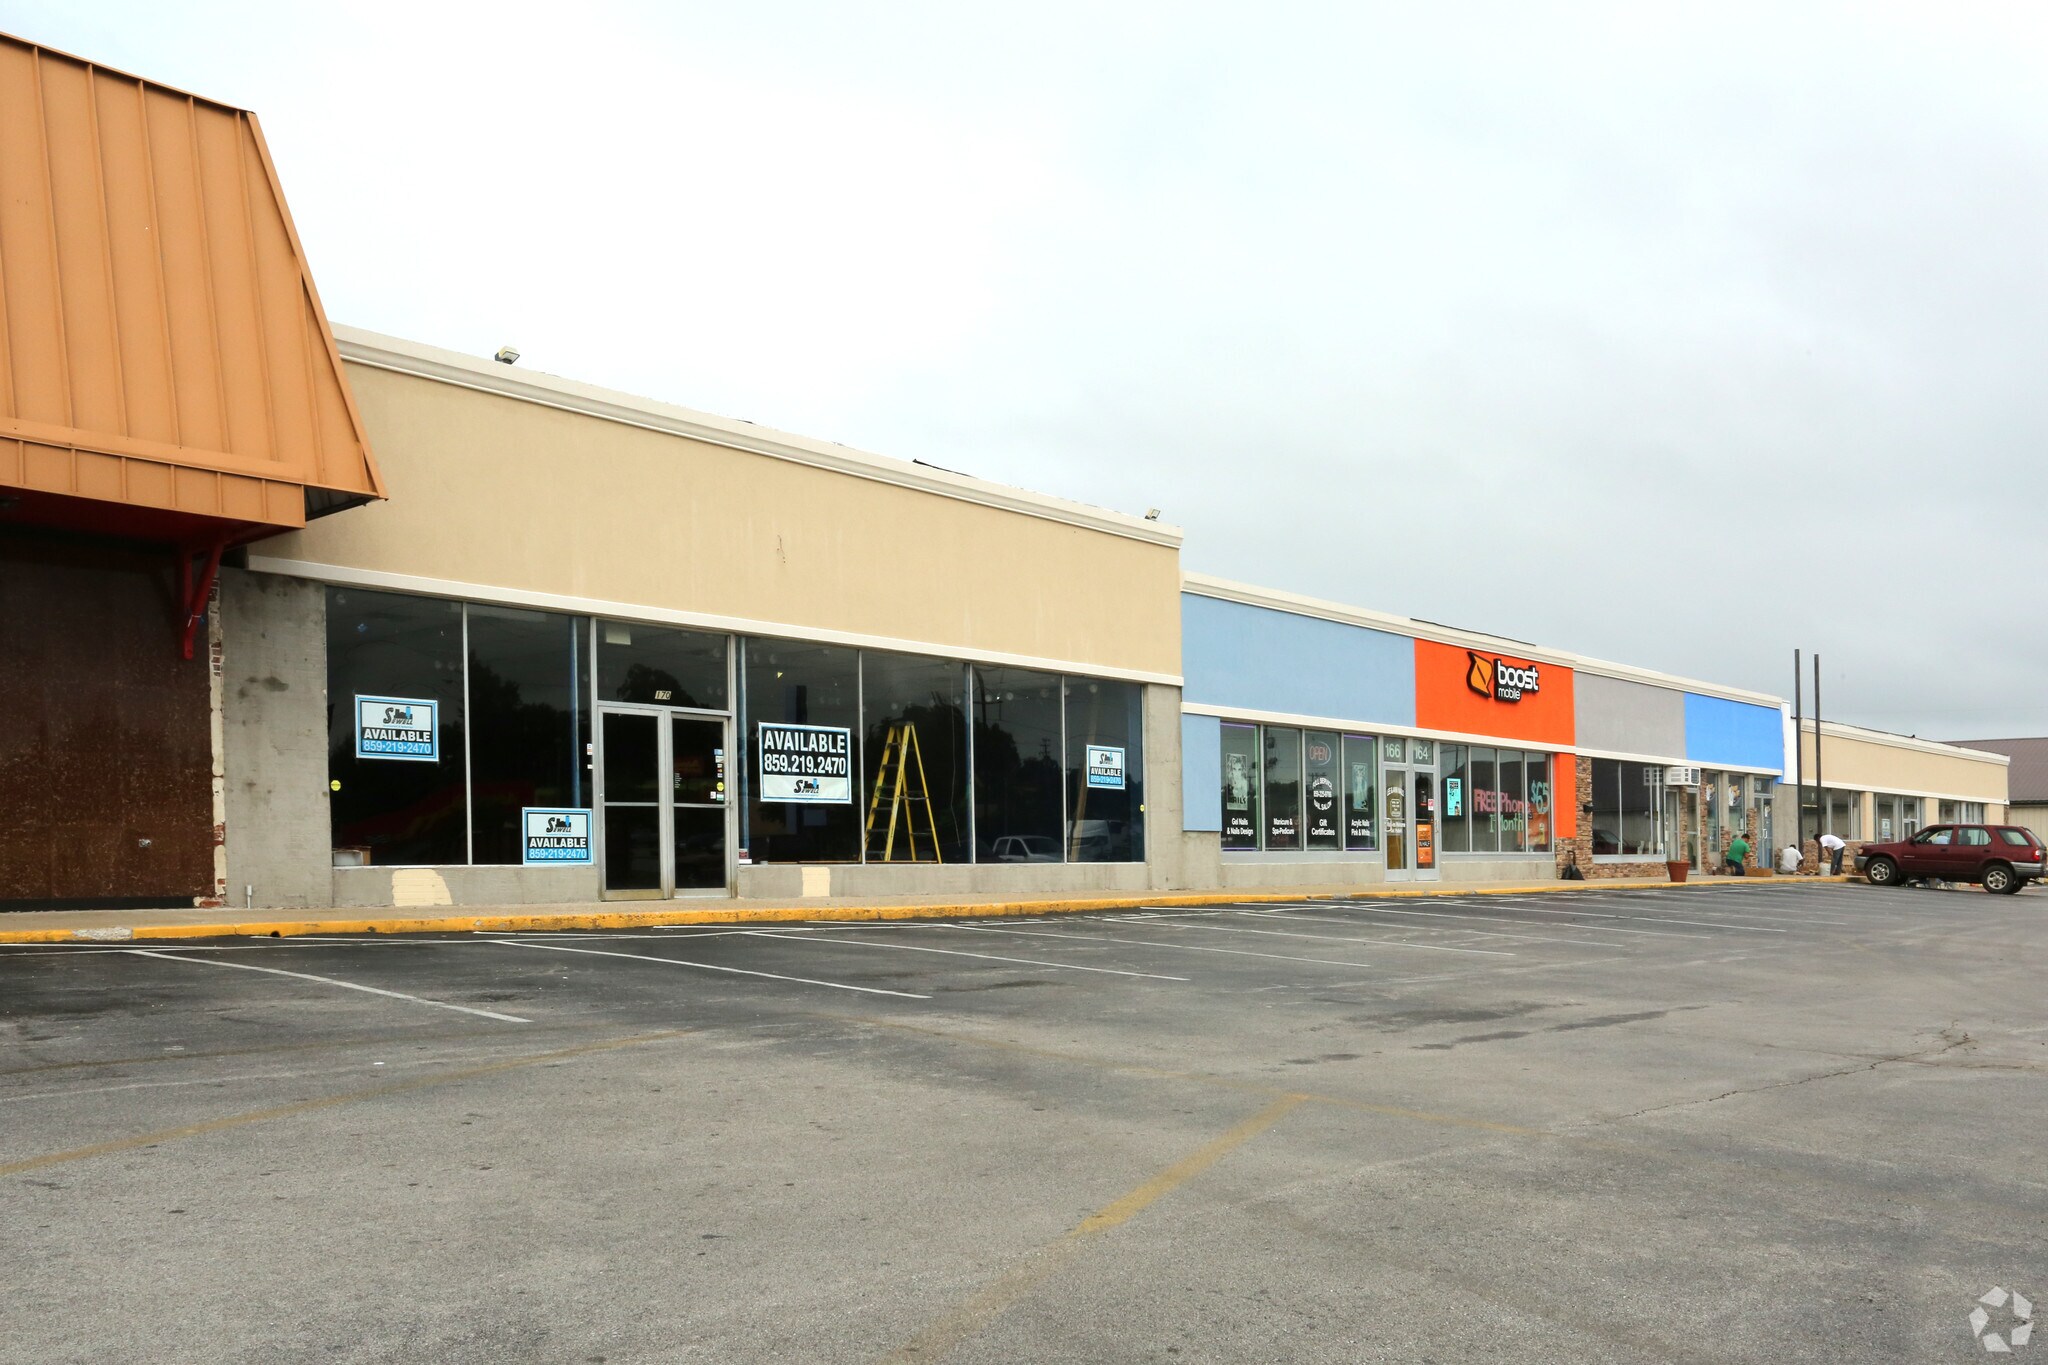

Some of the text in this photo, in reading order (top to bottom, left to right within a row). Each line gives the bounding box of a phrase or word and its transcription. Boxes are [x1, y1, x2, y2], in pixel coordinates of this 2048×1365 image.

[1498, 660, 1538, 690] boost
[657, 691, 670, 699] 170
[1498, 687, 1520, 700] mobile
[363, 728, 431, 742] AVAILABLE
[764, 730, 846, 754] AVAILABLE
[1309, 746, 1328, 761] OPEN
[1385, 743, 1400, 758] 166
[1415, 745, 1428, 760] 164
[764, 754, 846, 775] 859.219.2470
[1090, 768, 1122, 776] AVAILABLE
[1473, 788, 1496, 812] FREE
[1531, 779, 1550, 814] $65
[1240, 828, 1254, 836] Design
[529, 838, 587, 848] AVAILABLE
